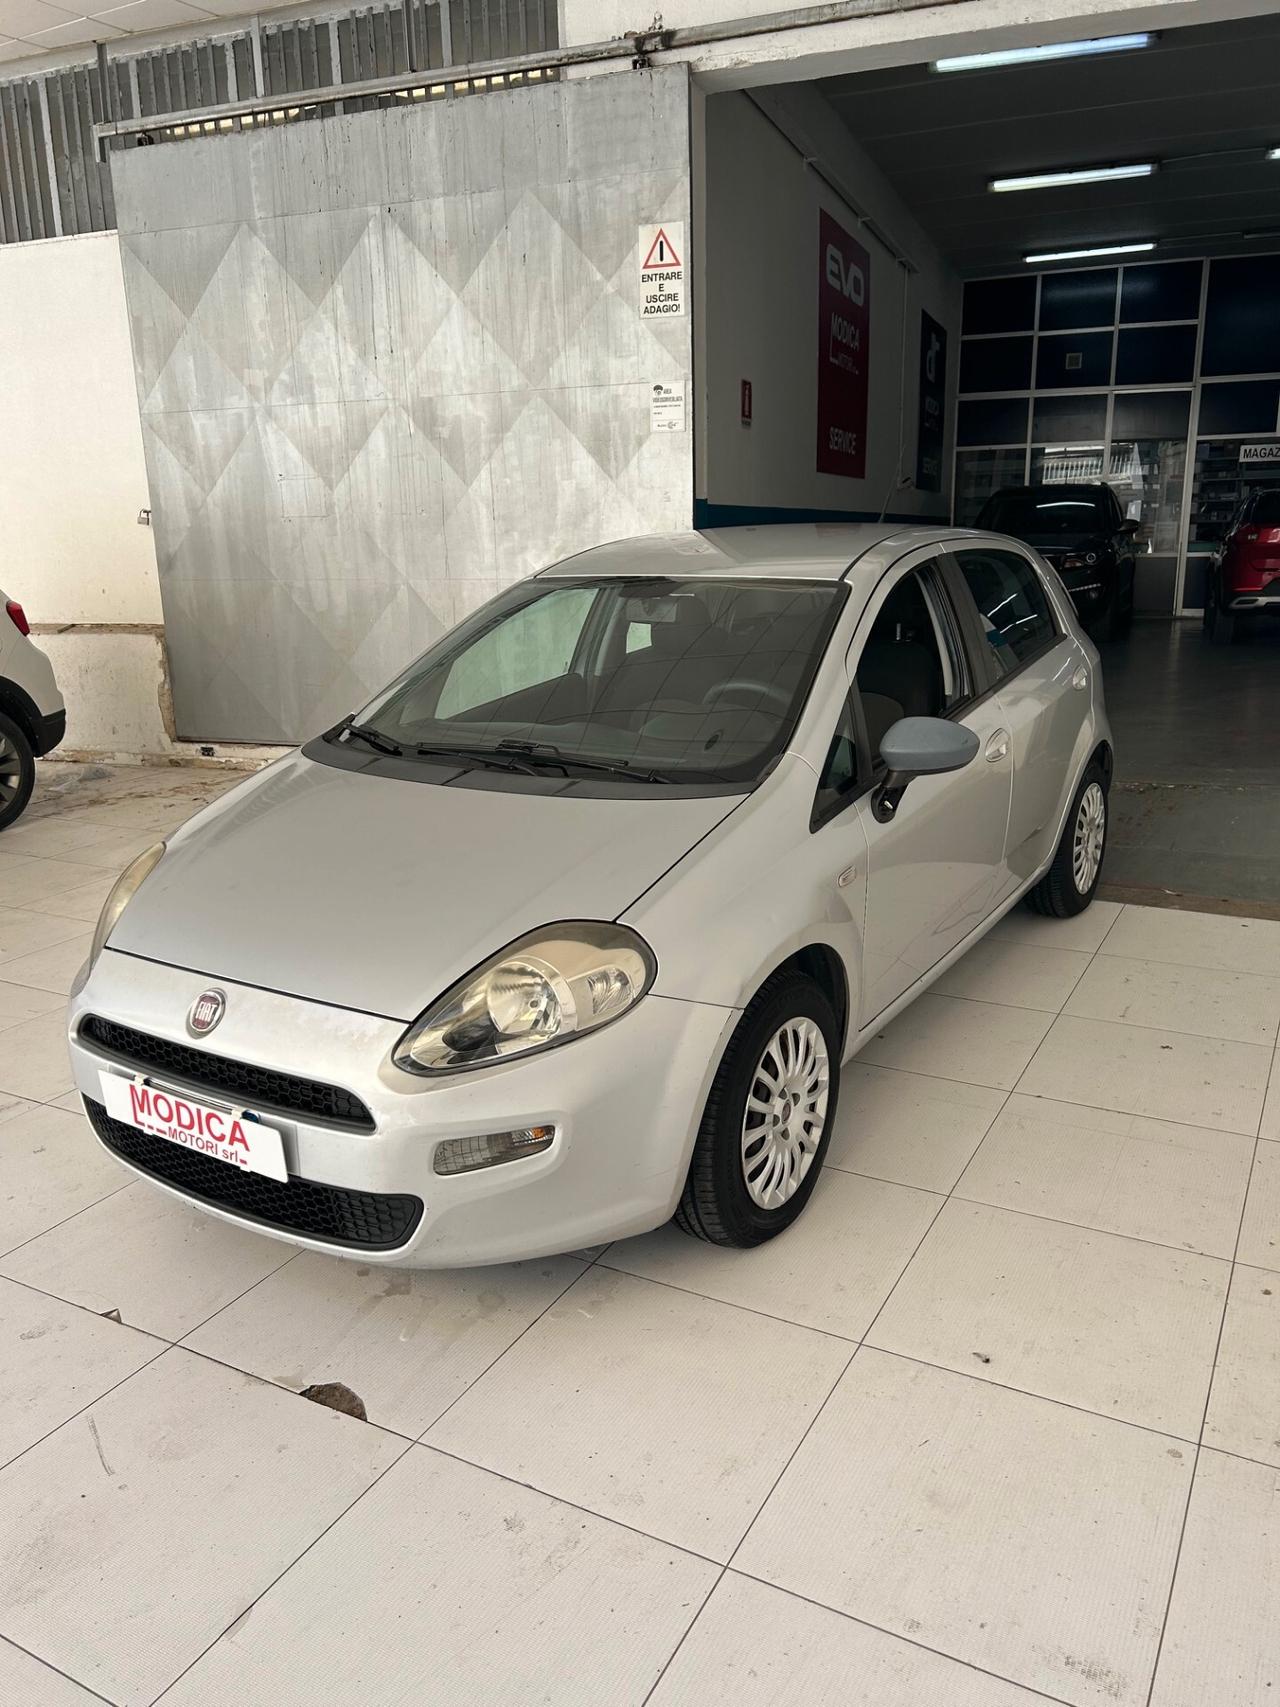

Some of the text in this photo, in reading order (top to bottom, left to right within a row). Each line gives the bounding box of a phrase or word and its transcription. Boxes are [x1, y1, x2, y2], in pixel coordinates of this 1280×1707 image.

[641, 271, 683, 283] ENTRARE
[826, 243, 864, 306] EVO
[658, 283, 665, 292] E
[646, 293, 679, 304] USCIRE
[643, 304, 681, 315] ADAGIO!
[831, 312, 859, 352] MODICA
[829, 426, 857, 455] SERVICE
[1243, 447, 1280, 459] MAGAZ
[195, 1001, 217, 1022] FIAT
[129, 1084, 250, 1152] MODICA
[168, 1126, 239, 1163] MOTORI srl
